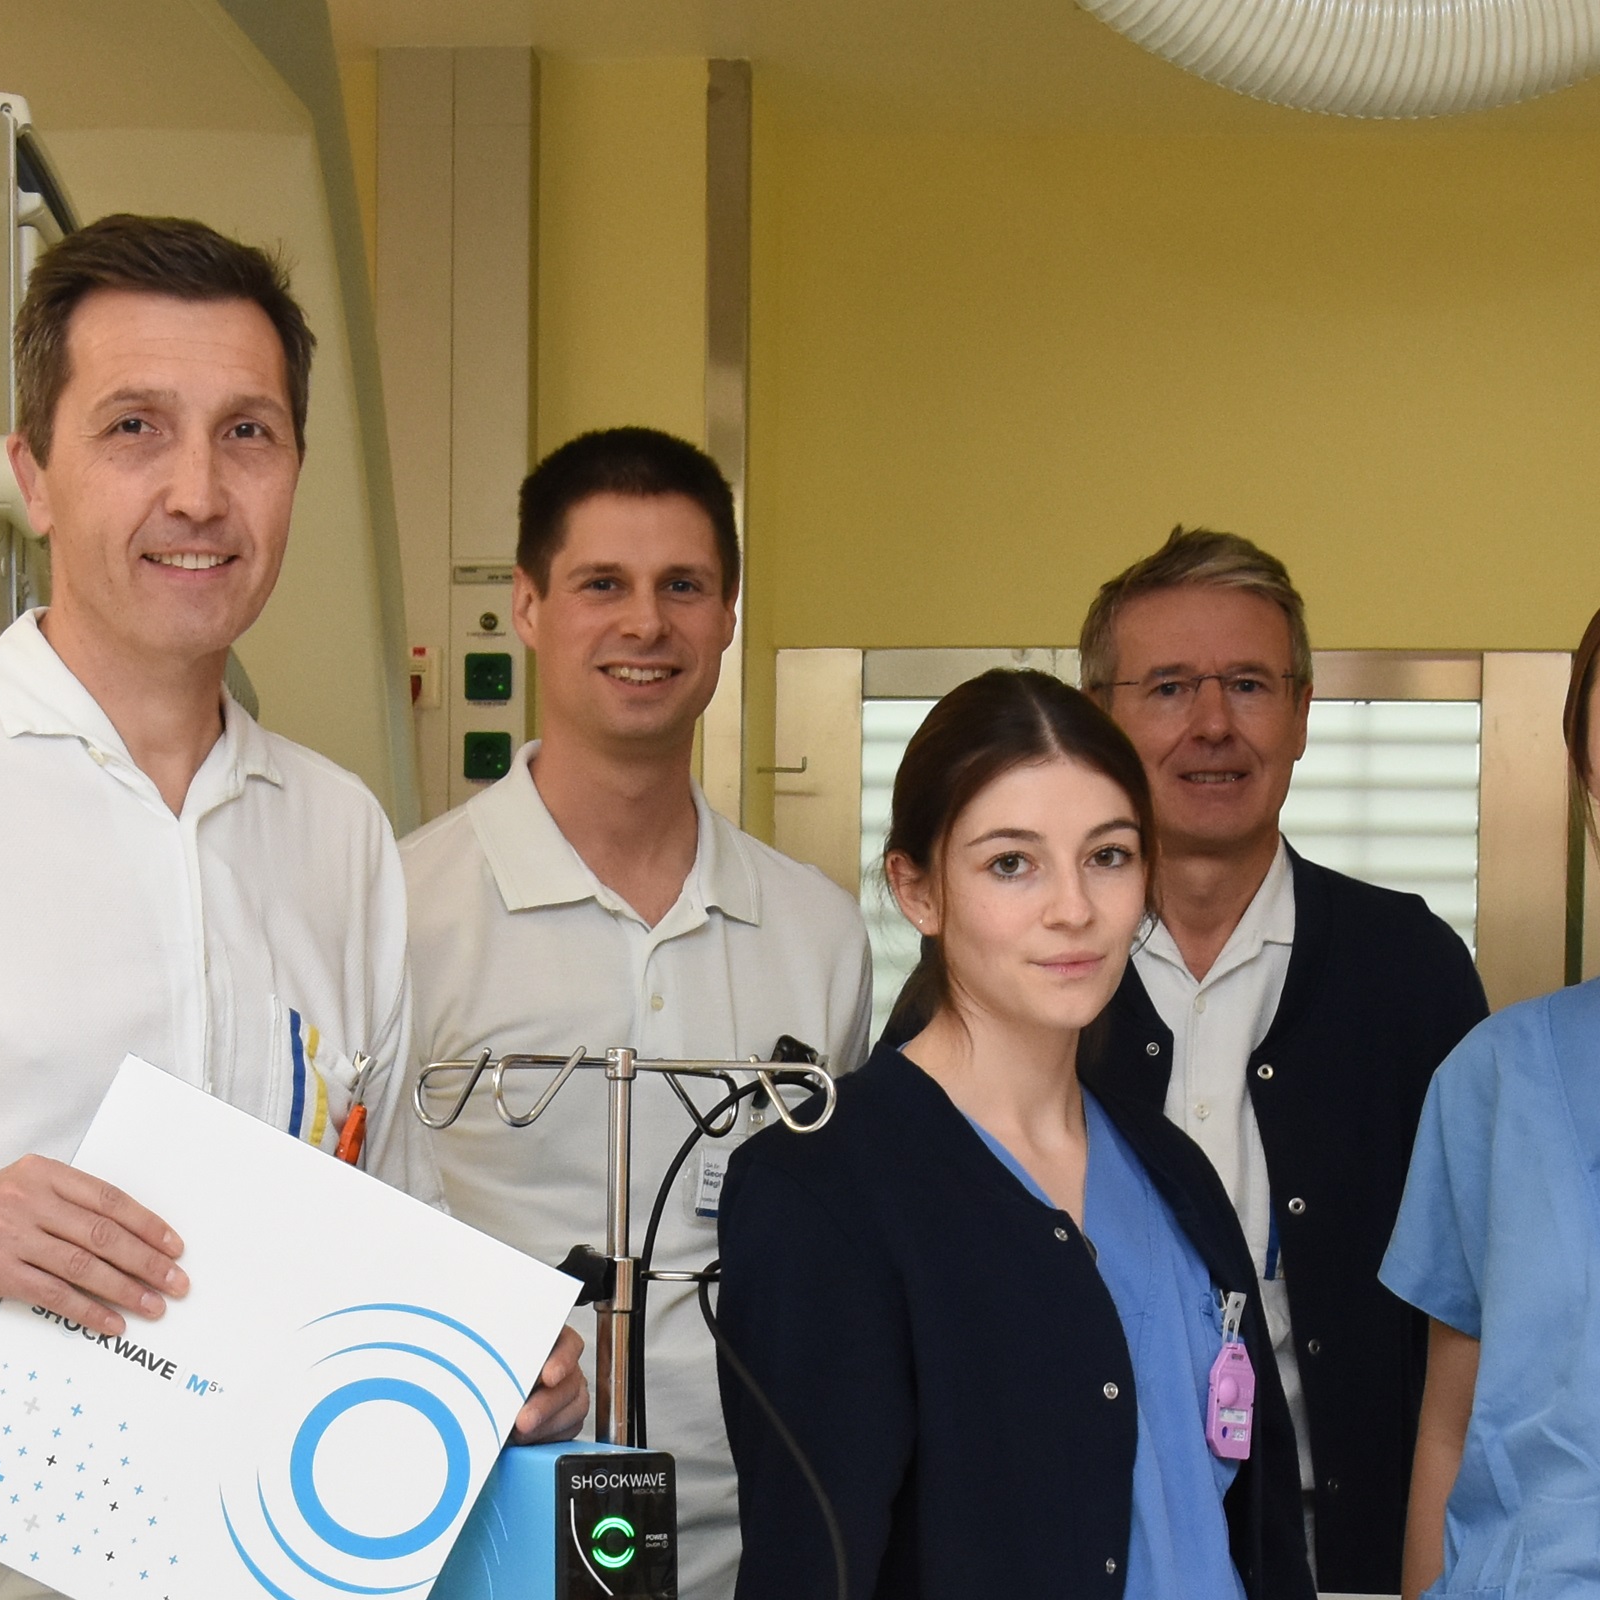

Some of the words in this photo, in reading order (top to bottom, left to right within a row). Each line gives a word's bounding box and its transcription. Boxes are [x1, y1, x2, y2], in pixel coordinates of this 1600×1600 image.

[704, 1169, 725, 1178] Geor
[571, 1472, 667, 1490] SHOCKWAVE
[645, 1533, 668, 1541] POWER
